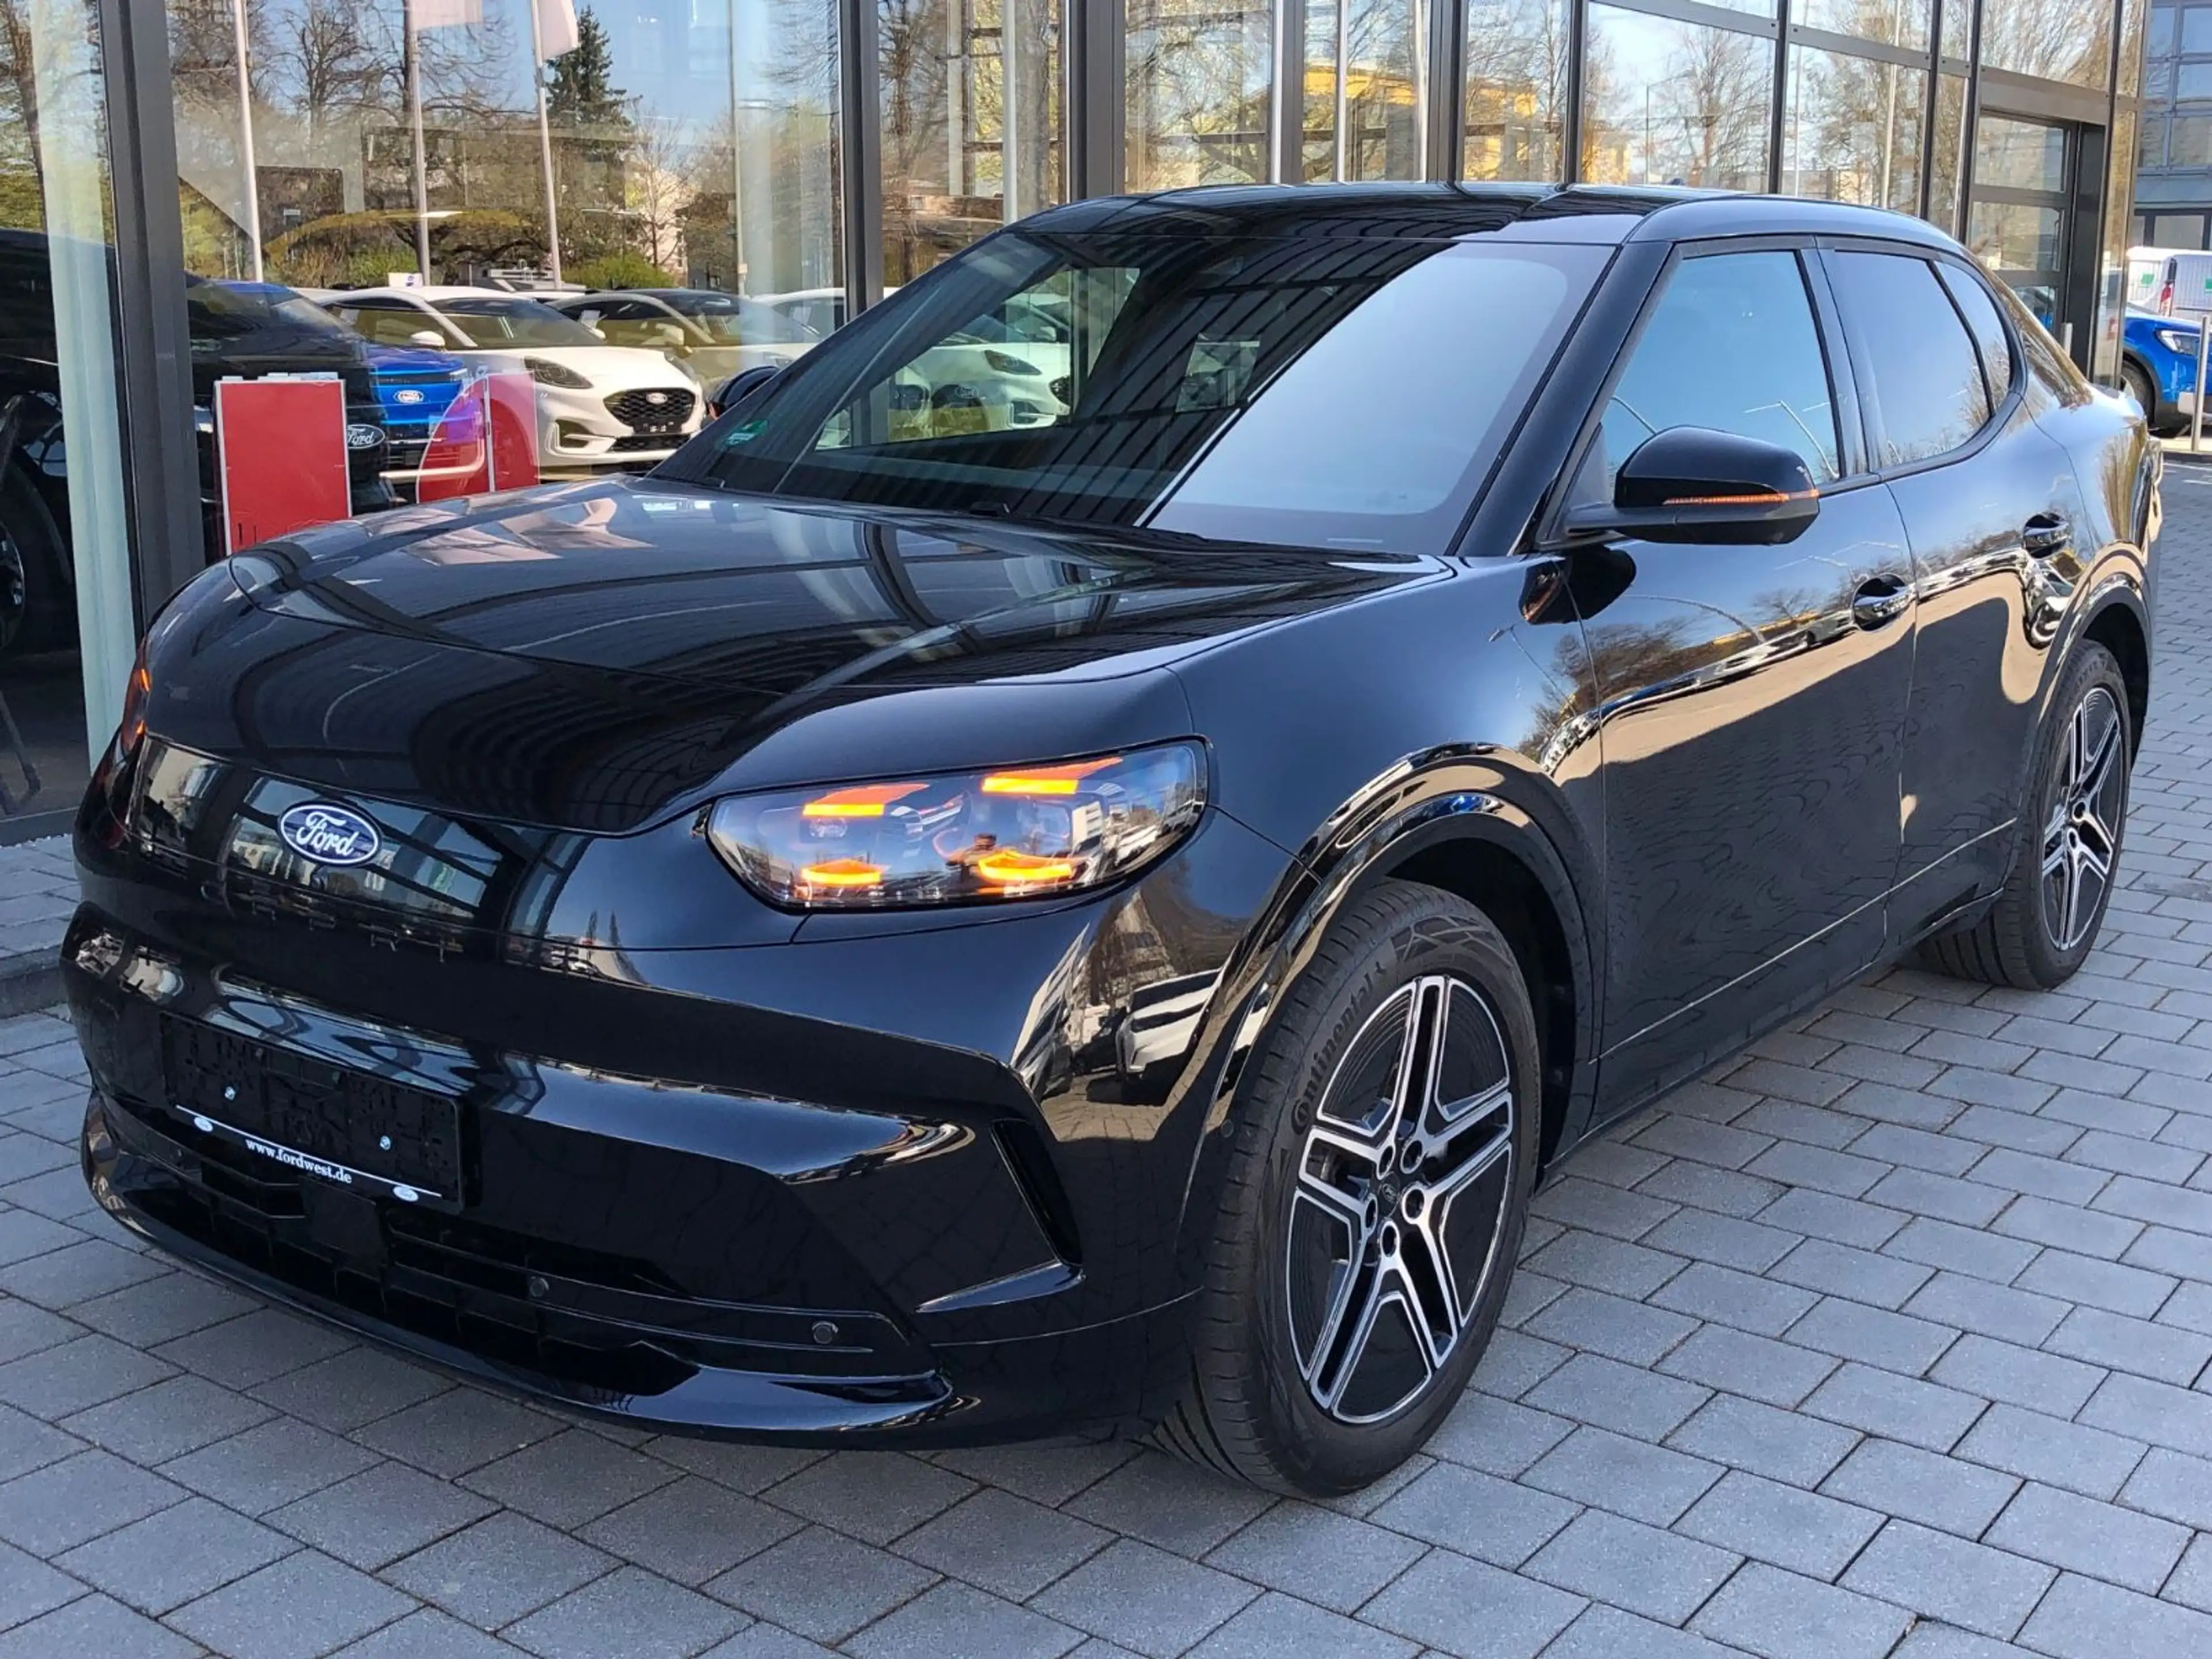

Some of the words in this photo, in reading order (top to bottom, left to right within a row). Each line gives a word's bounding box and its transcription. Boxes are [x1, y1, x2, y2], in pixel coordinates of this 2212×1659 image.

[296, 811, 358, 857] Ford
[1291, 973, 1375, 1135] Continental
[245, 1138, 353, 1184] www.fordwest.de
